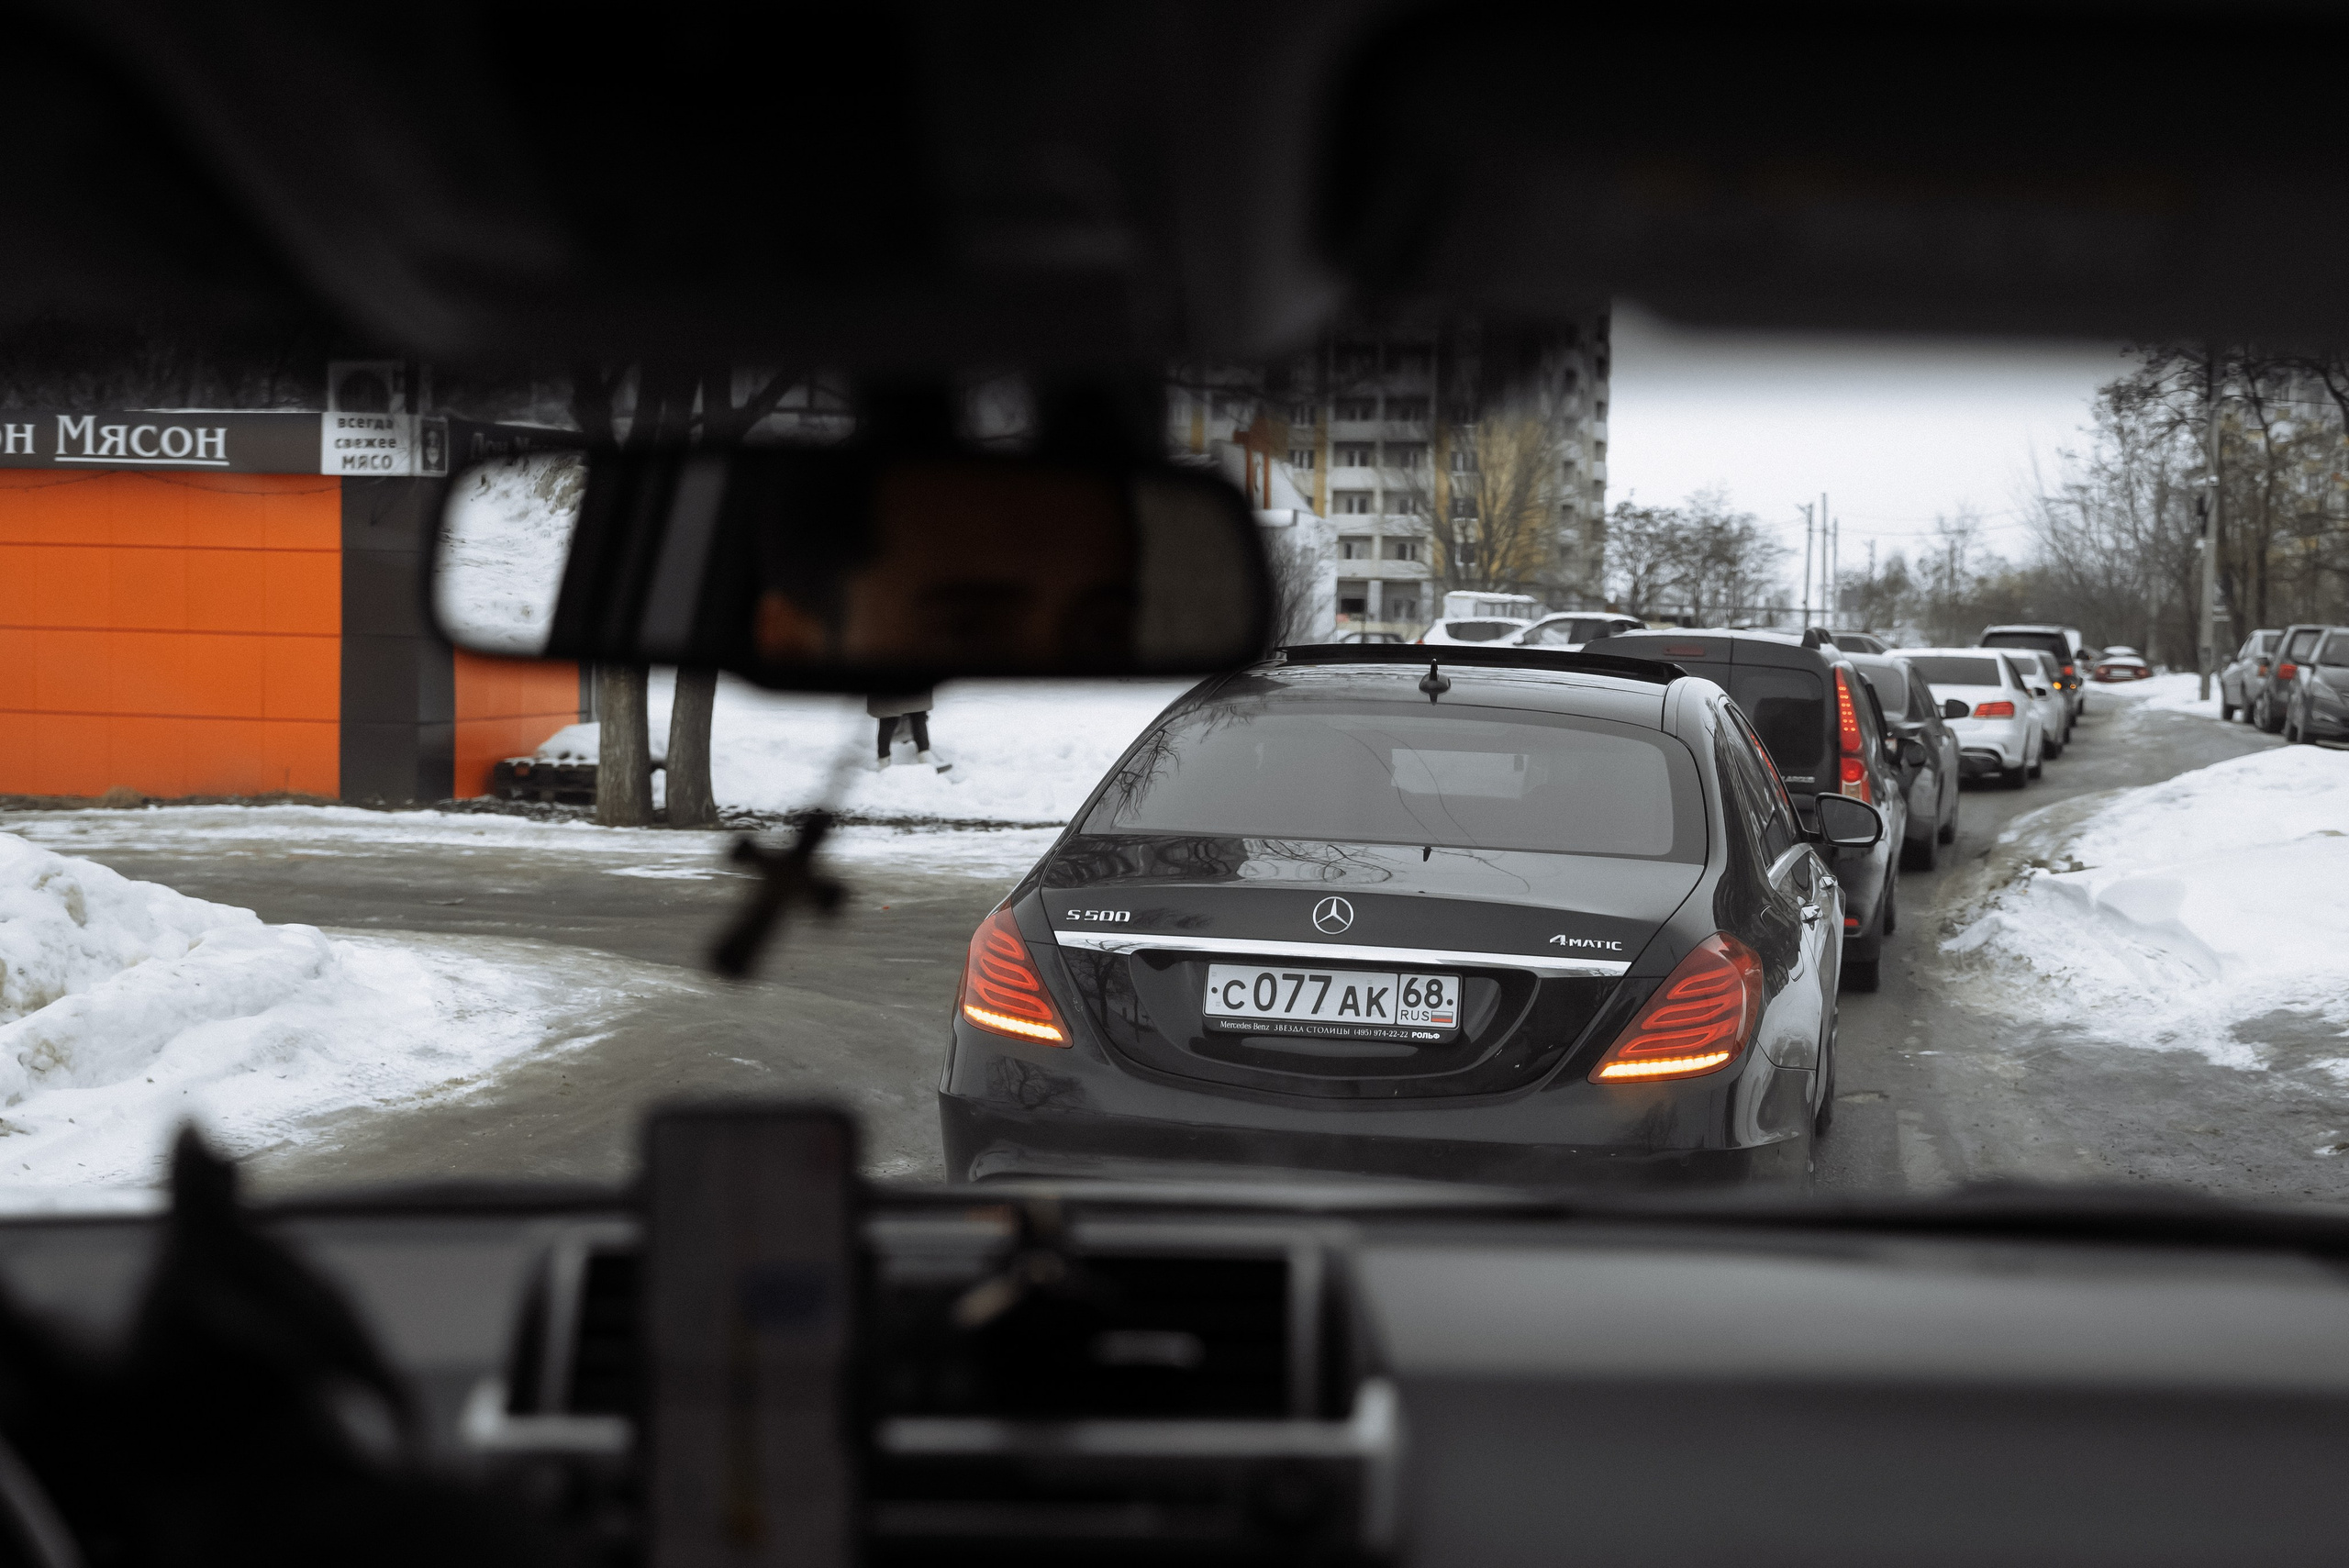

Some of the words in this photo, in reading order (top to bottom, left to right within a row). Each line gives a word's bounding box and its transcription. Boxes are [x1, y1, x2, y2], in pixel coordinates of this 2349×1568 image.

[337, 417, 395, 430] всегда
[0, 423, 37, 454] н
[55, 415, 228, 459] Мясон
[334, 438, 396, 449] свежее
[1084, 909, 1130, 923] 500
[1549, 934, 1623, 951] 4MATIC
[1402, 977, 1443, 1009] 68
[1400, 1009, 1430, 1021] RUS
[1219, 1020, 1252, 1030] Mercedes
[1252, 1022, 1270, 1031] Benz
[1274, 1024, 1304, 1033] ЗВЕЗДА
[1306, 1025, 1351, 1036] СТОЛИЦЫ
[1353, 1029, 1372, 1038] (495)
[1373, 1029, 1408, 1039] 974-22-22
[1411, 1031, 1441, 1040] РОЛЬФ
